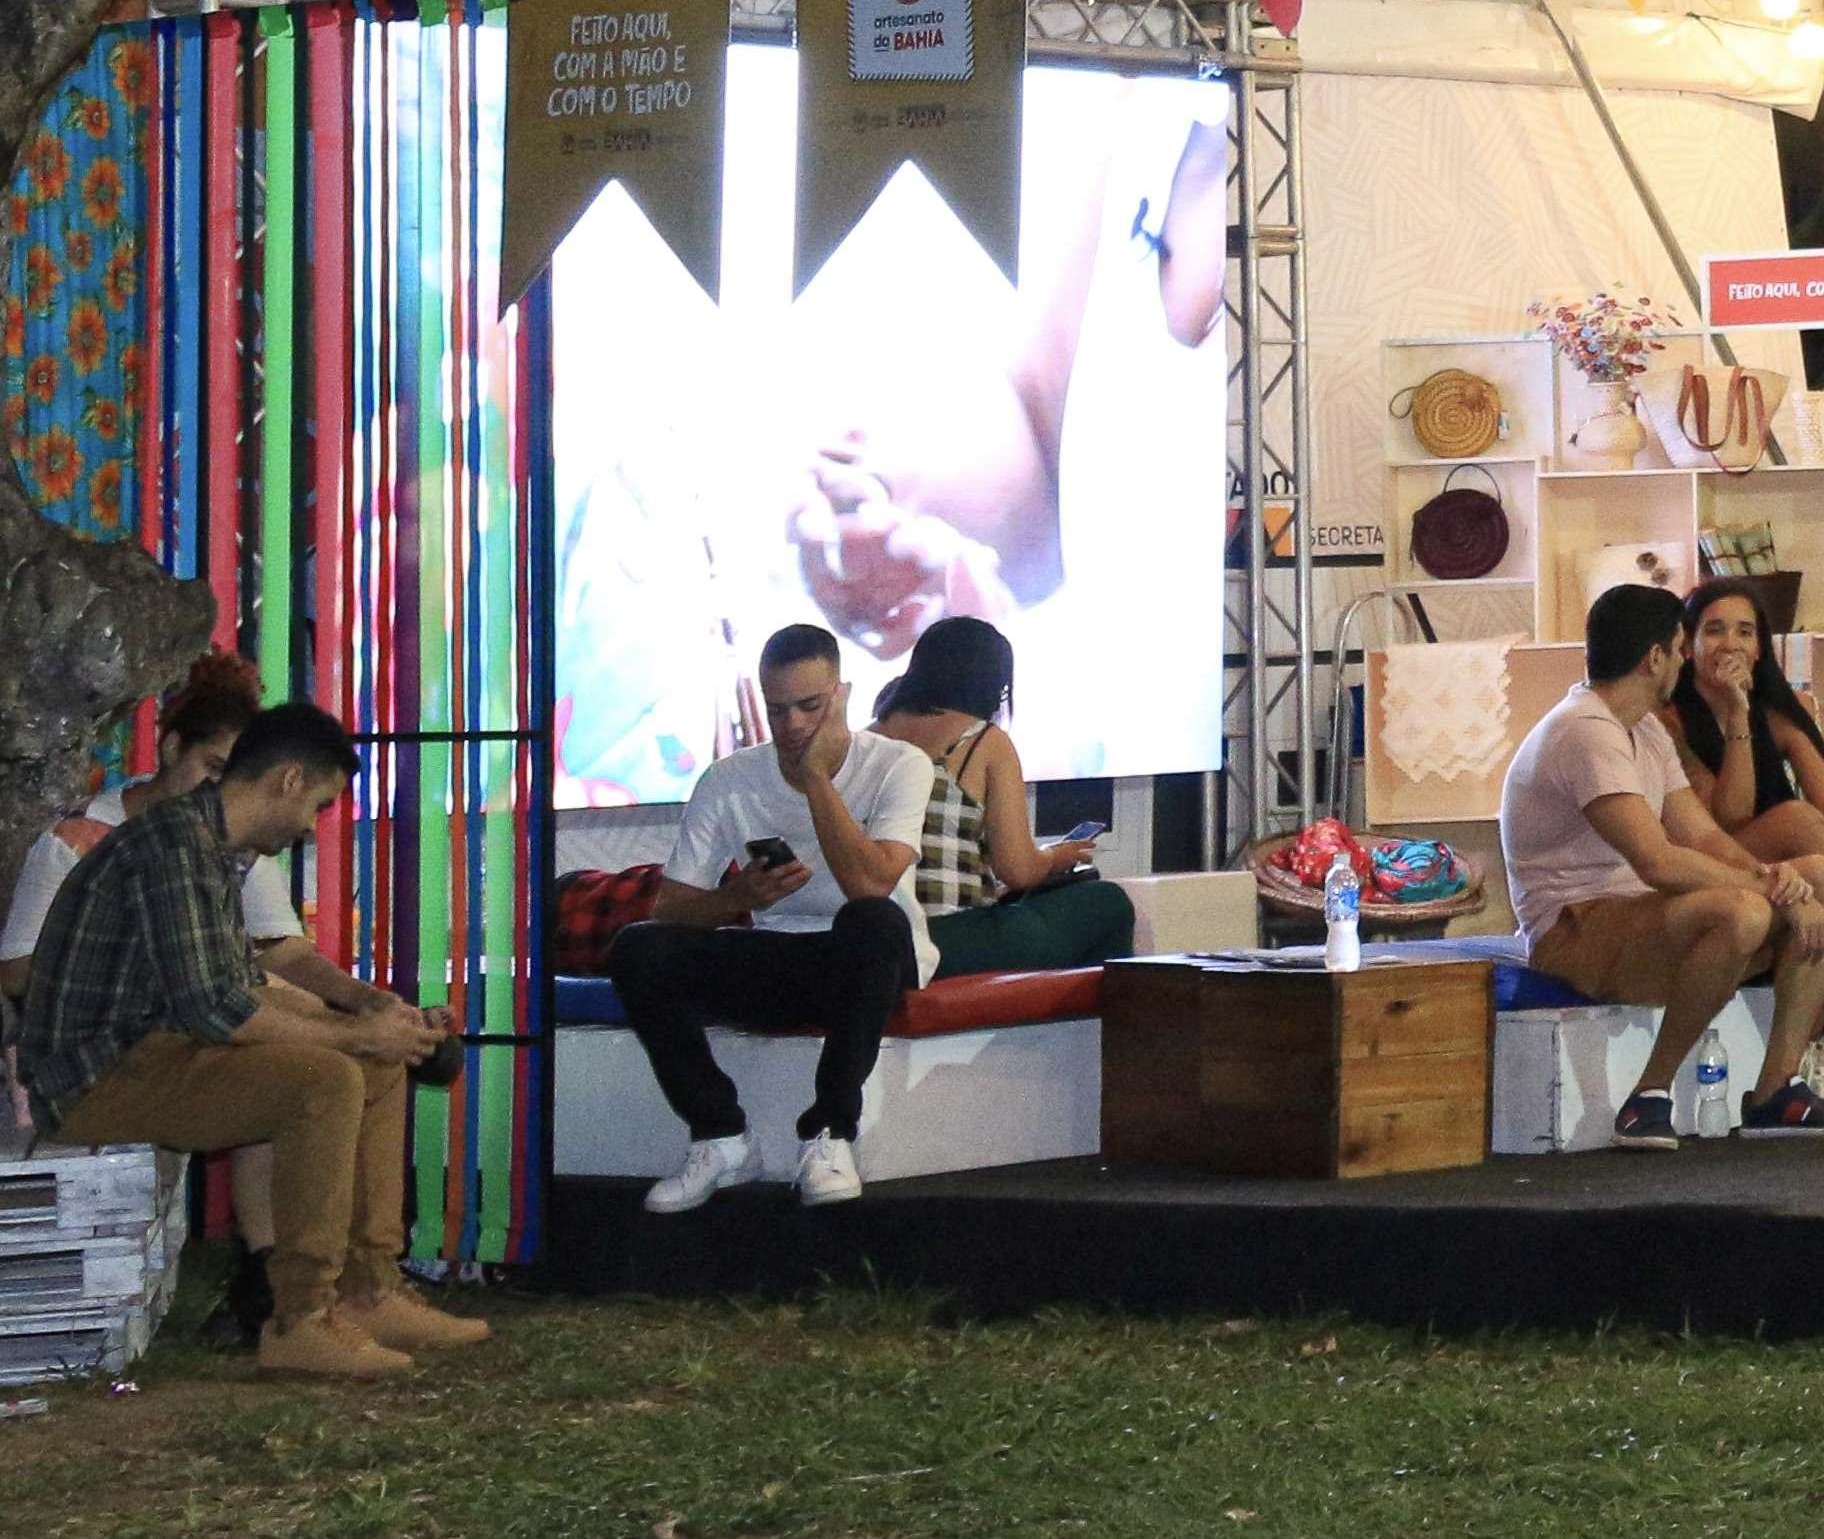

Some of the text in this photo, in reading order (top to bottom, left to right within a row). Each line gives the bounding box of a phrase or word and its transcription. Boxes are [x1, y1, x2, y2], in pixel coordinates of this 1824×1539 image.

[571, 13, 672, 45] FEITO AQUI,
[874, 10, 945, 29] artesanato
[874, 28, 944, 50] da BAHIA
[554, 45, 686, 81] COM A MÃO E
[547, 80, 691, 117] COM O TEMPO
[1728, 283, 1763, 300] FEITO
